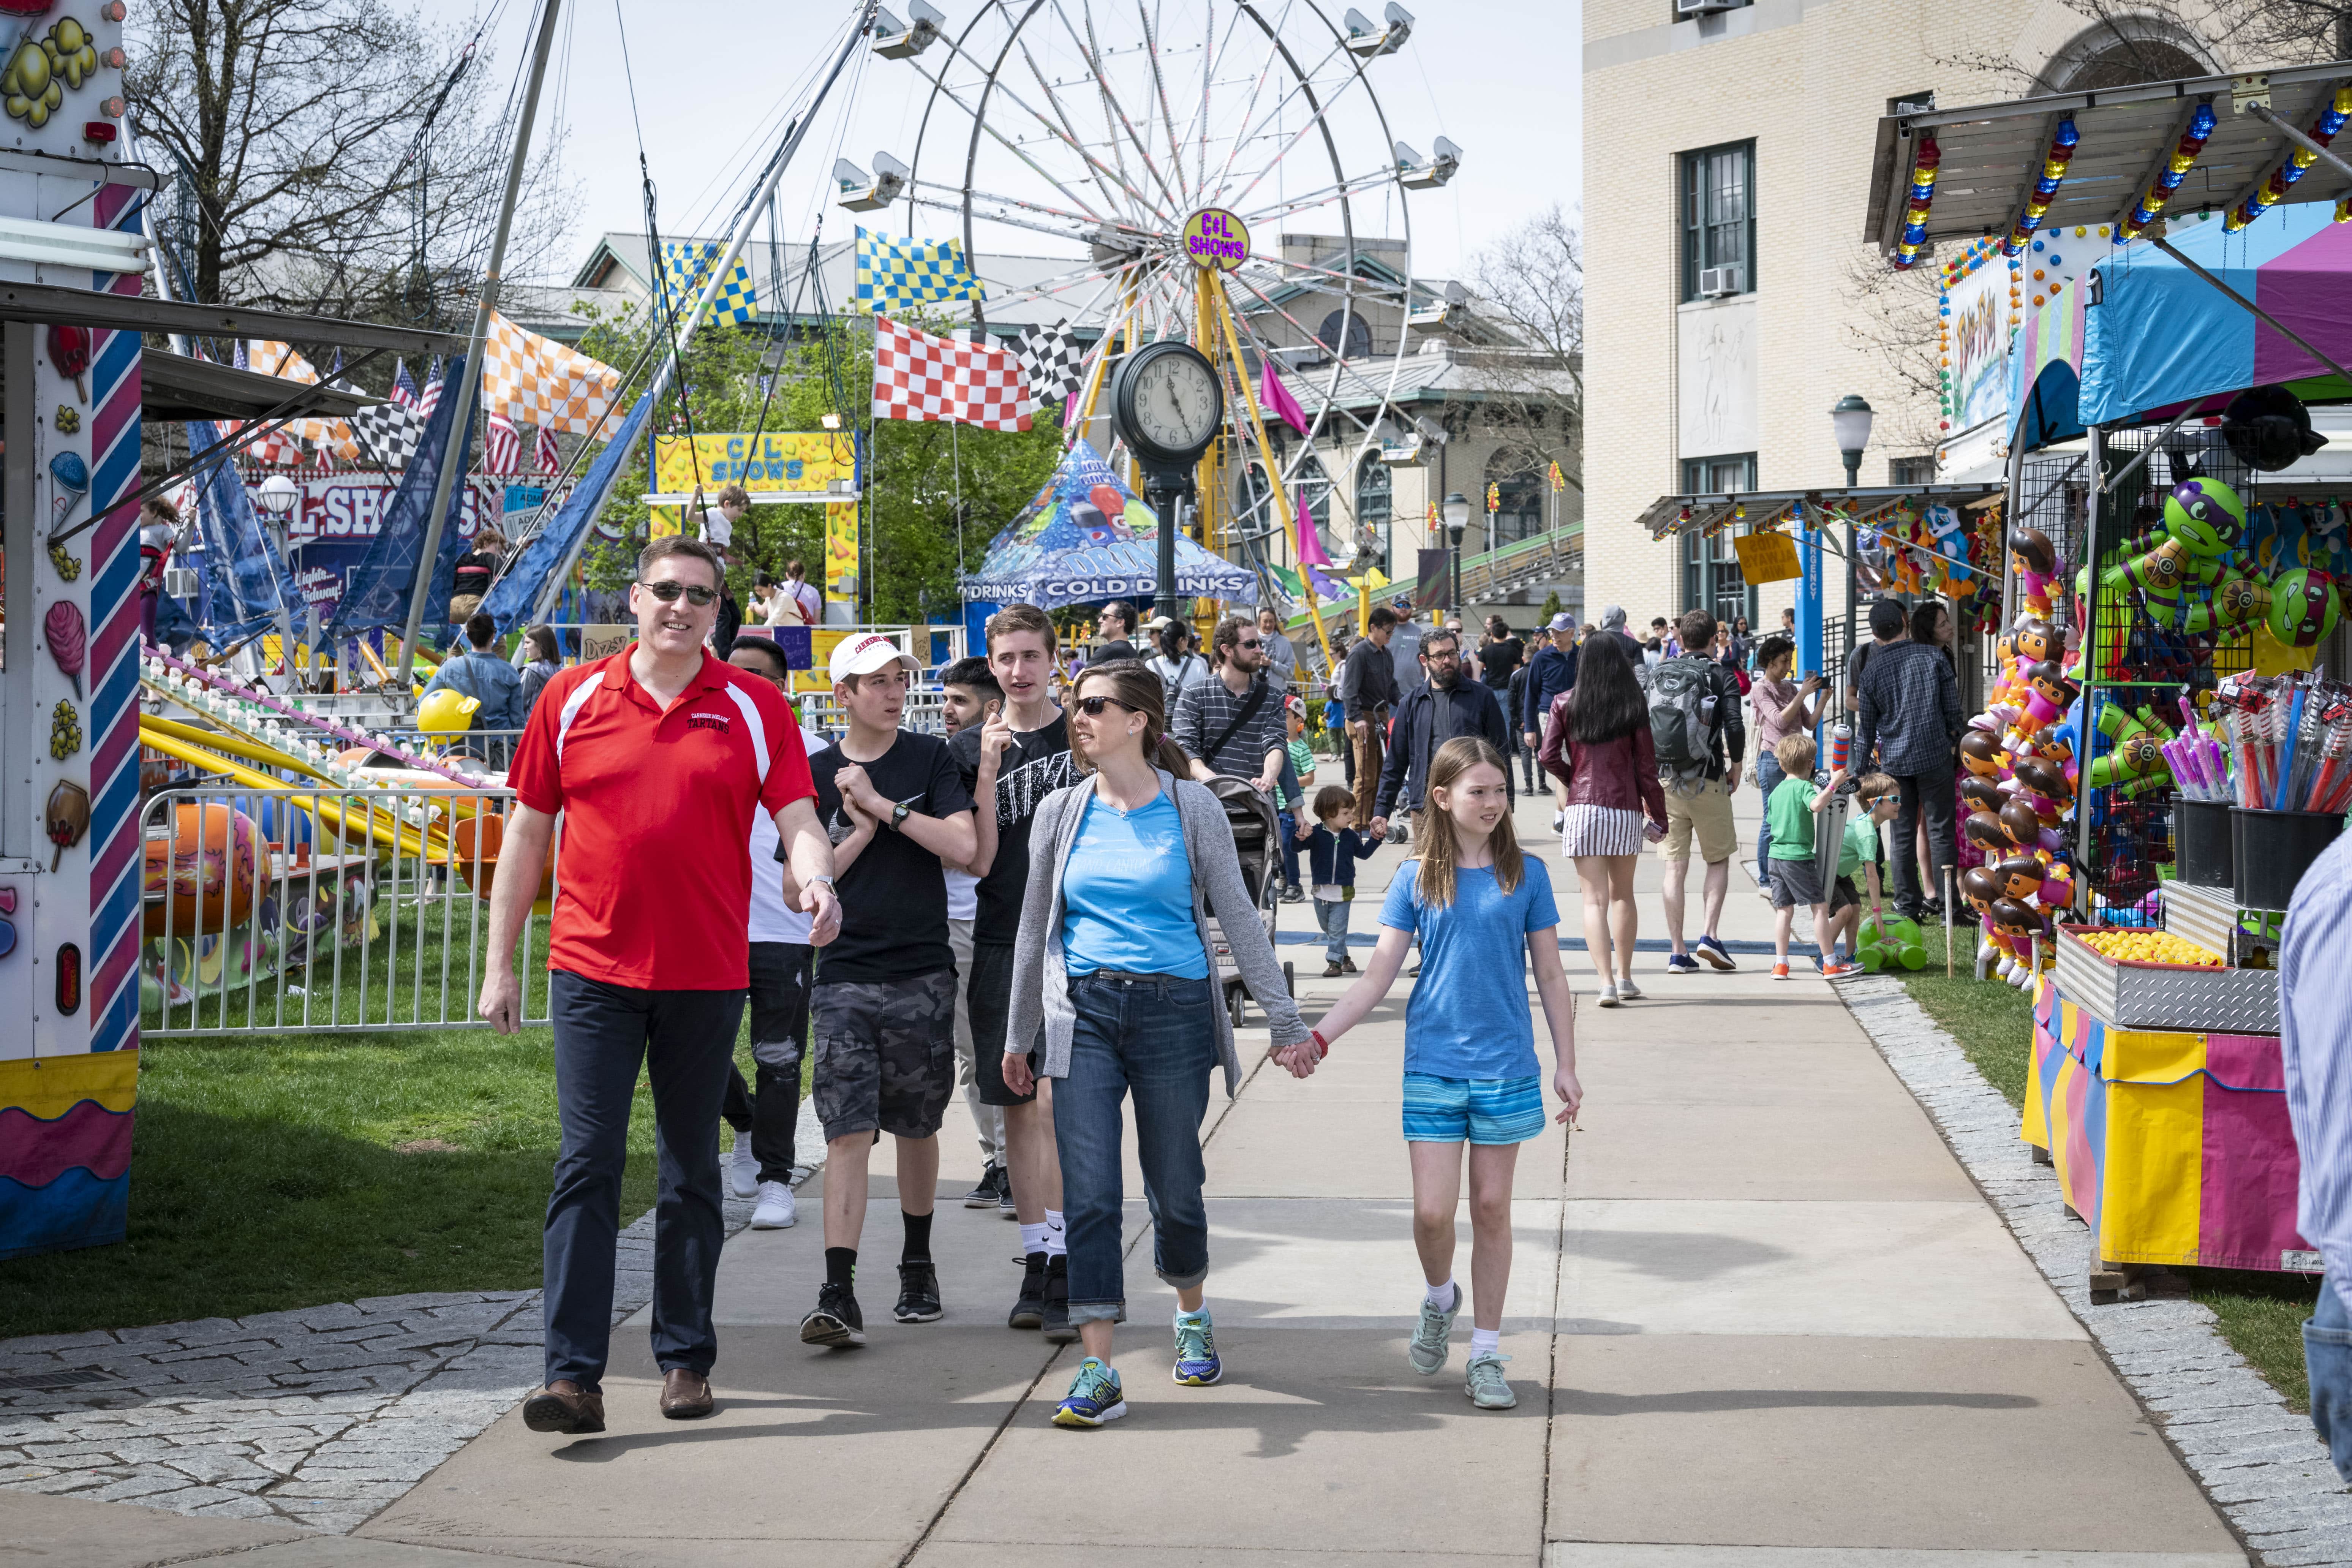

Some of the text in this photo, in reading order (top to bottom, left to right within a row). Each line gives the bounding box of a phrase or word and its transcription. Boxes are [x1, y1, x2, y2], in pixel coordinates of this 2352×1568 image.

[1202, 213, 1234, 238] C&L
[1189, 235, 1244, 260] SHOWS
[1154, 364, 1161, 377] 11
[1168, 361, 1180, 374] 12
[1143, 376, 1152, 389] 10
[1196, 379, 1204, 392] 2
[1140, 394, 1147, 407] 9
[1200, 396, 1208, 410] 3
[1144, 412, 1151, 425] 8
[1194, 415, 1203, 428] 4
[1154, 425, 1162, 438] 7
[1170, 430, 1177, 444] 6
[712, 460, 803, 481] SHOWS
[971, 584, 1027, 599] DRINKS
[1046, 577, 1243, 596] COLD DINKS
[687, 718, 730, 735] TARTANS
